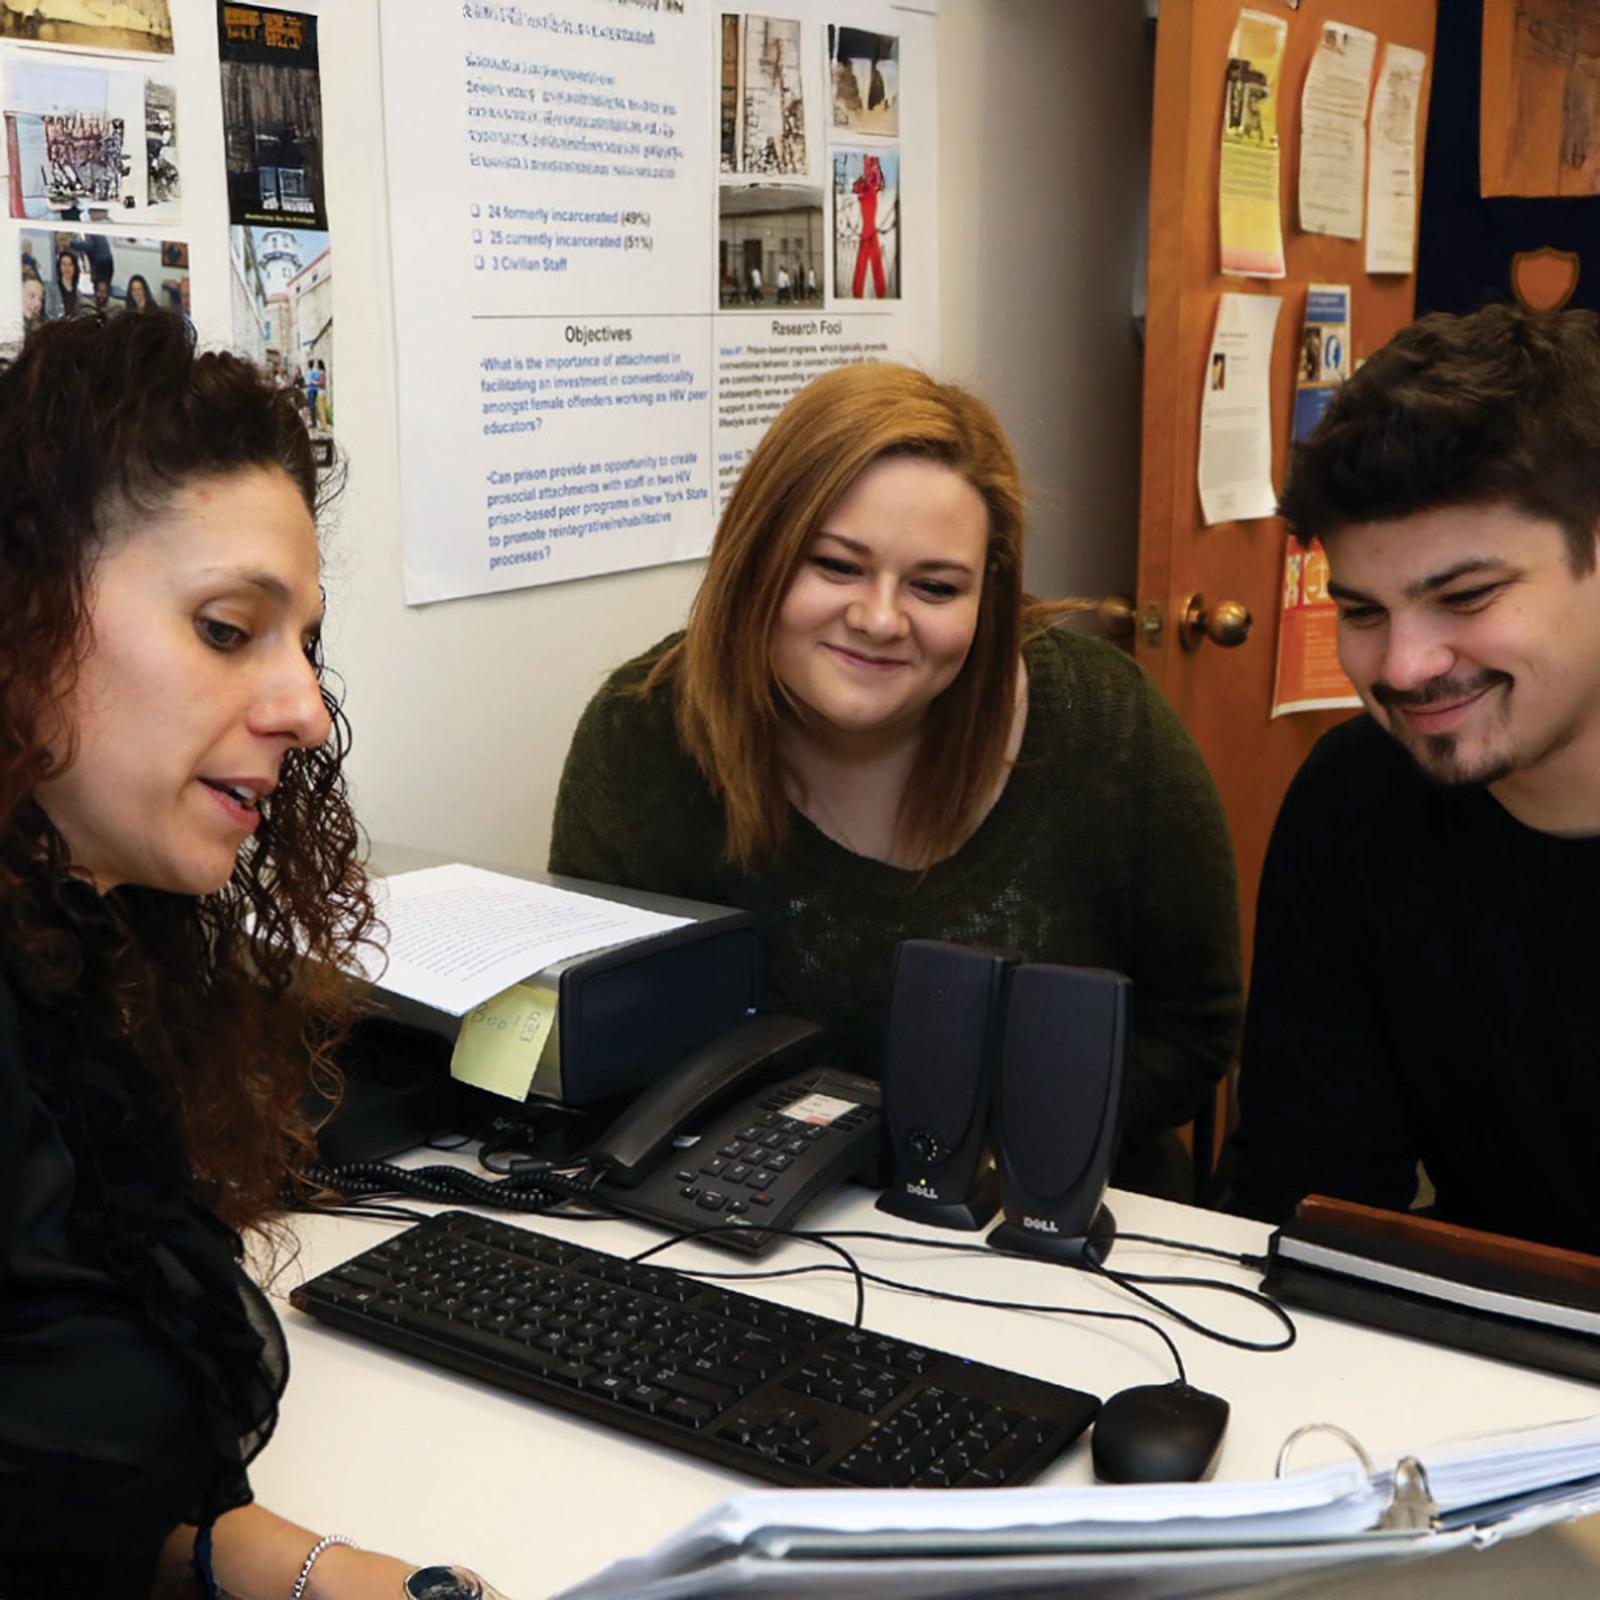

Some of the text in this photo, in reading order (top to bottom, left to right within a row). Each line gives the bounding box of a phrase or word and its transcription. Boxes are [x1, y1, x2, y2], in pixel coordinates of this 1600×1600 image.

[503, 205, 549, 224] formerly
[552, 207, 619, 223] incarcerated
[506, 232, 551, 249] currently
[555, 233, 621, 249] incarcerated
[624, 235, 653, 251] (51%)
[501, 257, 541, 271] Civilian
[542, 257, 568, 271] Staff
[565, 325, 632, 346] Objectives
[772, 320, 842, 336] Research Foci
[515, 358, 523, 370] is
[526, 357, 542, 369] the
[545, 356, 600, 371] importance
[602, 354, 613, 366] of
[615, 353, 669, 367] attachment
[671, 352, 681, 364] in
[481, 370, 694, 395] facilitating an investment in conventionality
[482, 389, 709, 416] amongst female offenders working as HIV peer
[483, 417, 543, 436] educators?
[514, 468, 547, 484] prison
[550, 465, 588, 482] provide
[590, 463, 602, 475] an
[604, 456, 658, 474] opportunity
[659, 455, 669, 468] to
[670, 452, 698, 467] create
[487, 470, 692, 508] prosocial attachments with staff in two HIV
[488, 486, 709, 528] prison-based peer programs in New York State
[489, 534, 501, 548] to
[503, 528, 547, 548] promote
[489, 545, 551, 571] processes?
[907, 1182, 939, 1199] DELL
[1023, 1216, 1059, 1233] DELL
